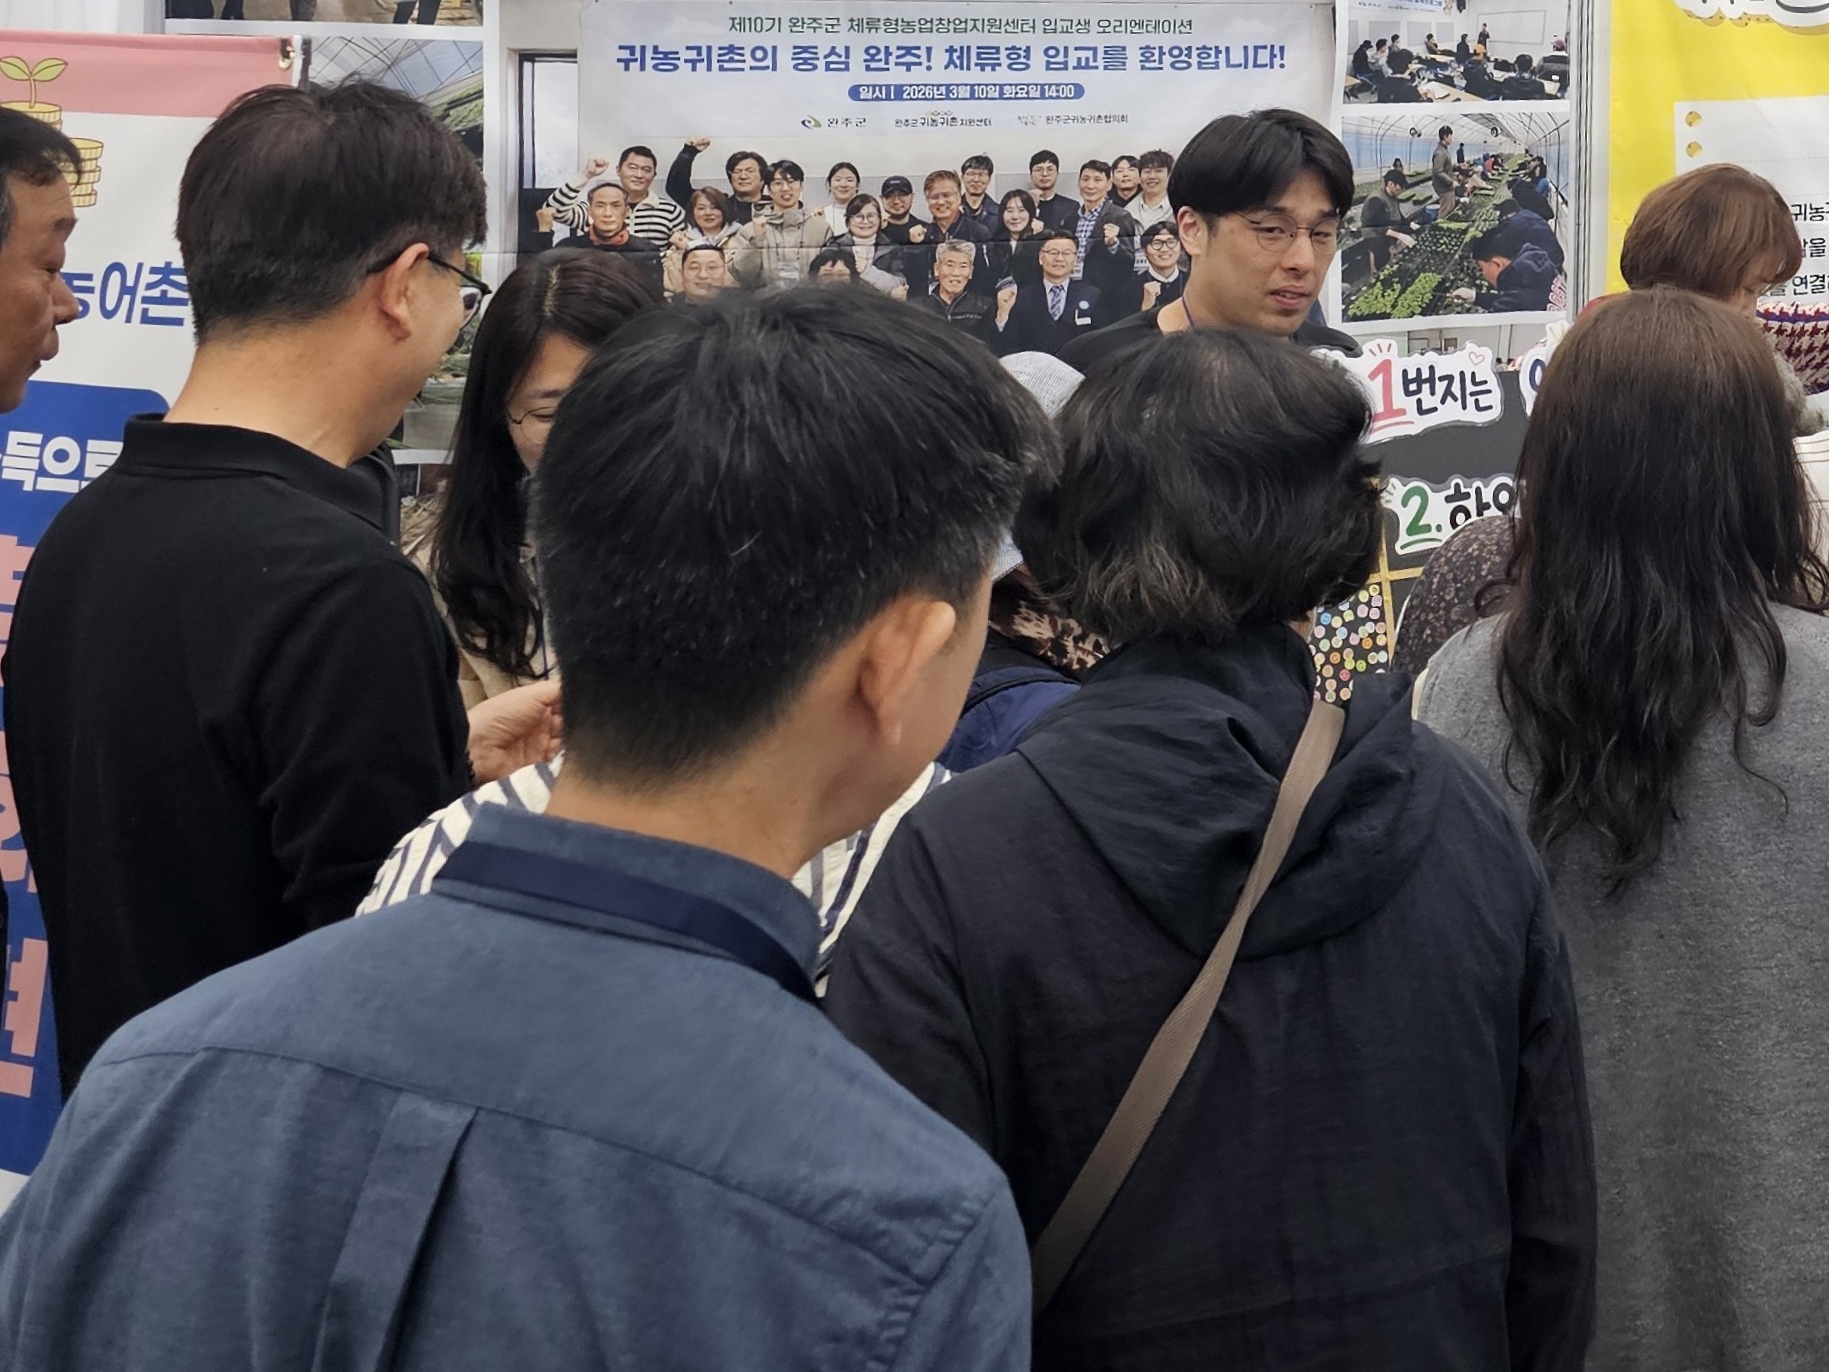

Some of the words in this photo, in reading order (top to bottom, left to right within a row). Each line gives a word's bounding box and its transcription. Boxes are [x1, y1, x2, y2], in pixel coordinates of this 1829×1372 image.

[729, 17, 782, 34] 제10기
[789, 17, 842, 34] 완주군
[847, 17, 1035, 35] 체류형농업창업지원센터
[1042, 18, 1091, 35] 입교생
[1096, 19, 1192, 35] 오리엔테이션
[617, 44, 778, 73] 귀농귀촌의
[791, 44, 850, 73] 중심
[863, 44, 933, 72] 완주!
[944, 45, 1032, 72] 체류형
[1043, 44, 1129, 71] 입교를
[1139, 44, 1286, 70] 환영합니다!
[859, 85, 886, 100] 일시
[902, 85, 945, 100] 2026년
[950, 85, 970, 99] 3월
[974, 85, 1000, 99] 10일
[1002, 85, 1041, 99] 화요일
[1044, 85, 1075, 98] 14:00
[1401, 485, 1442, 536] 2.
